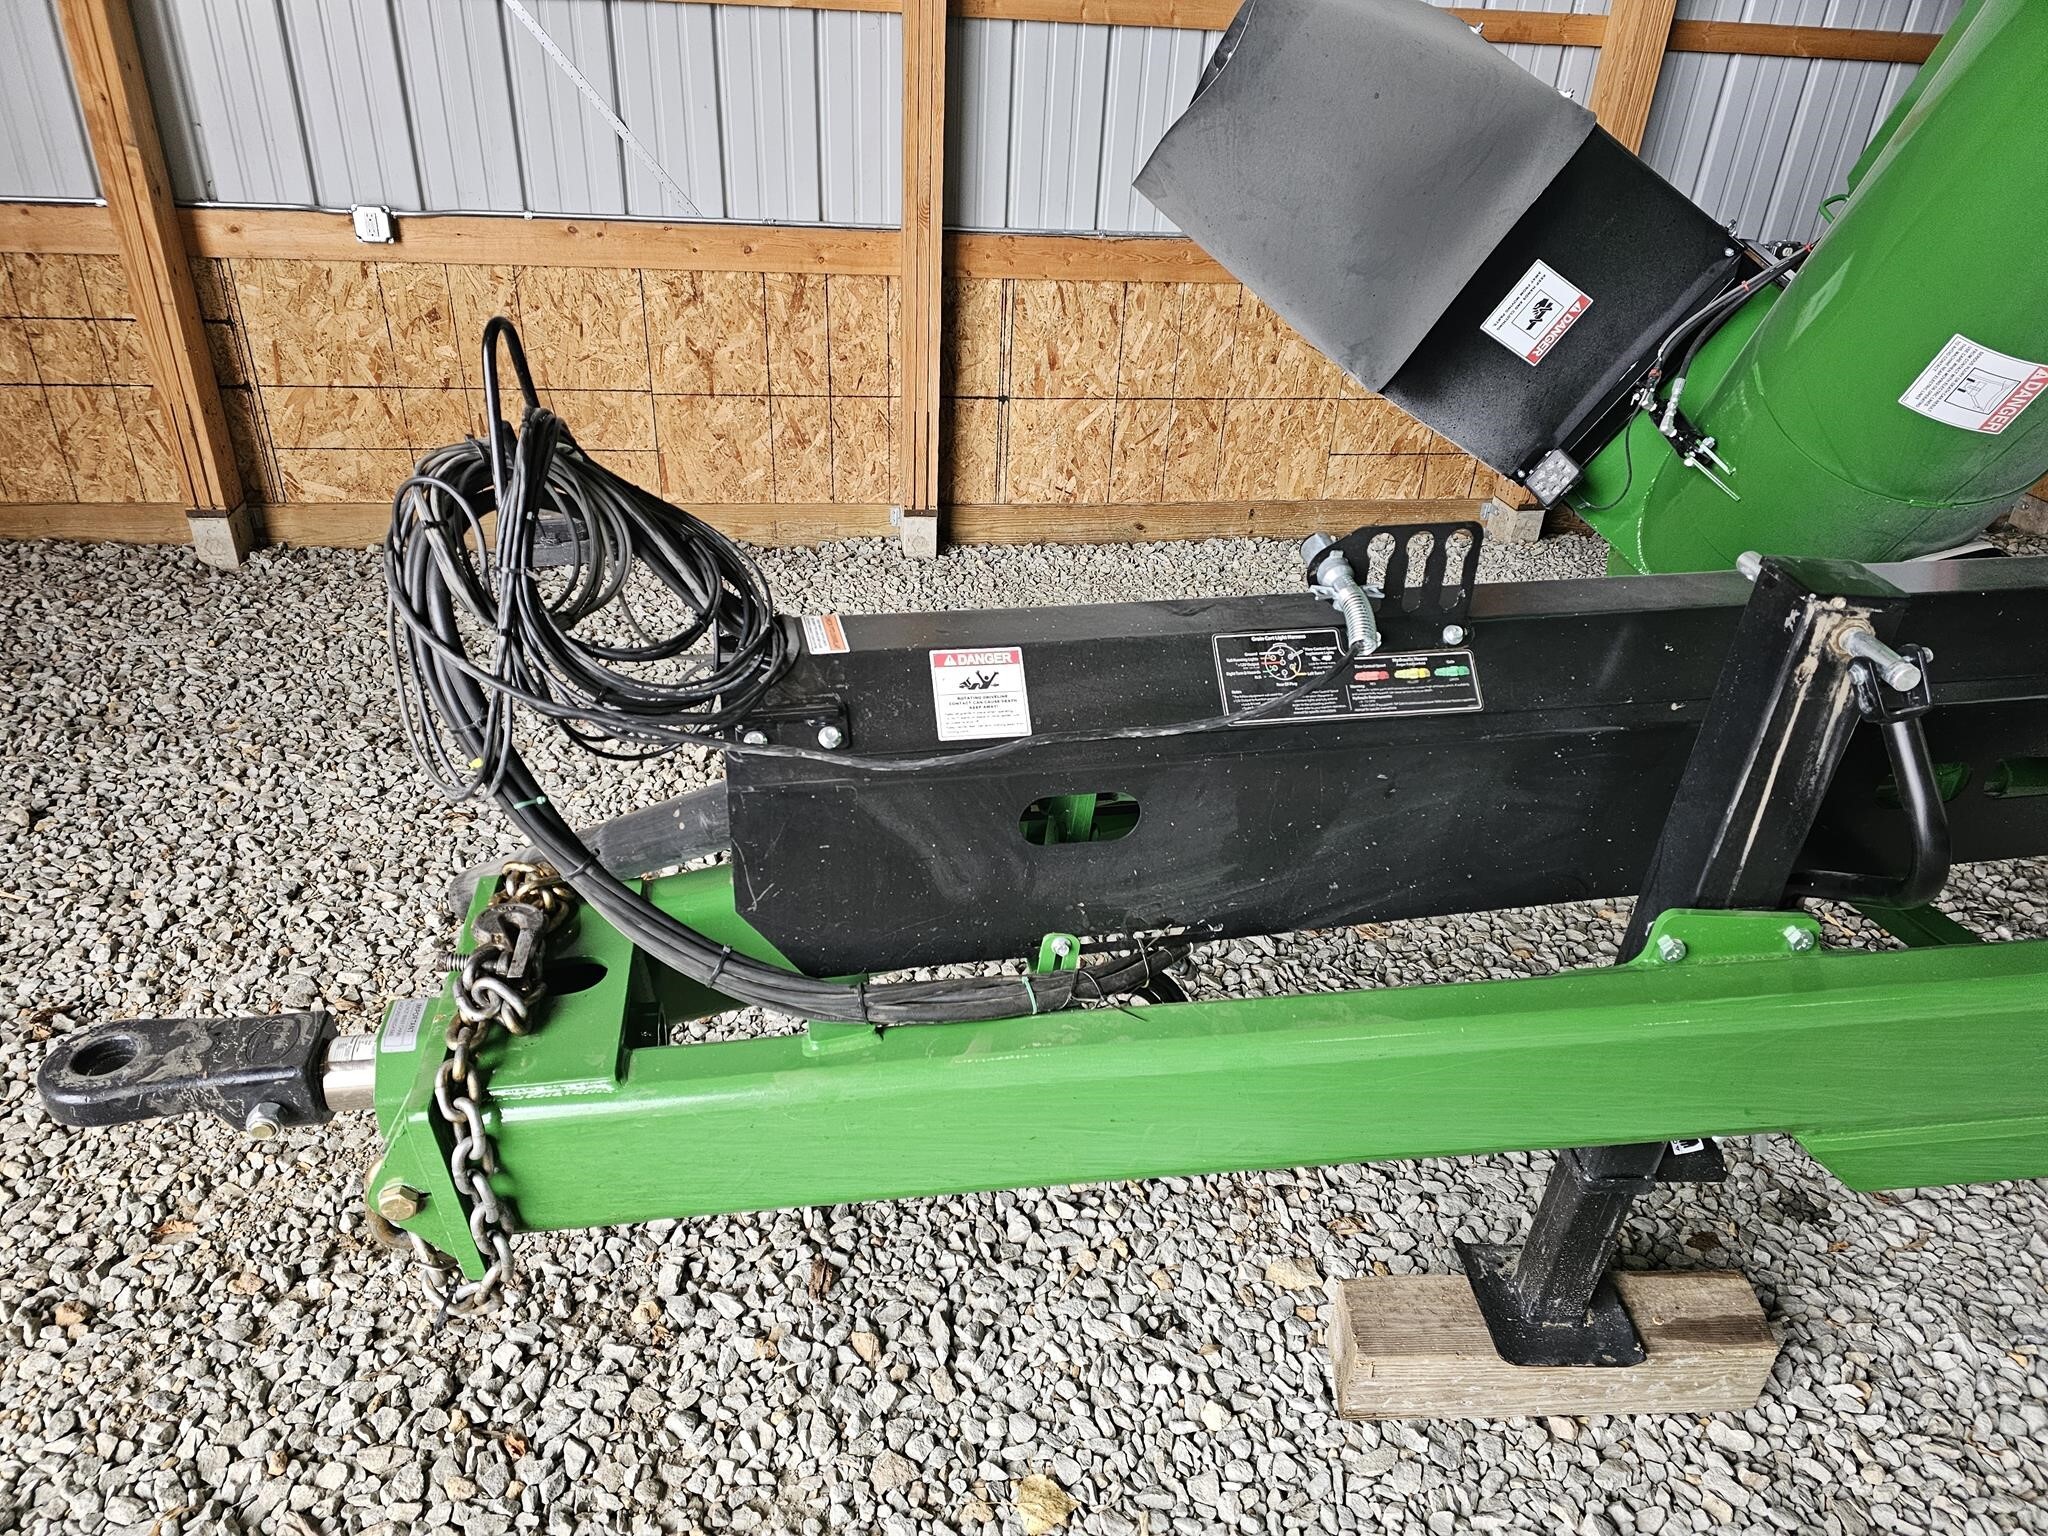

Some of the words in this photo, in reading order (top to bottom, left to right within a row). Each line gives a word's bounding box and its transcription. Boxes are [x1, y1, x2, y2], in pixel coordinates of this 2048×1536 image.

[1520, 284, 1530, 296] FROM
[1506, 297, 1520, 313] MOVING
[1533, 313, 1574, 357] DANGER
[1984, 380, 2042, 431] DANGER
[957, 652, 1013, 665] DANGER
[407, 1002, 422, 1032] IMPORTANT
